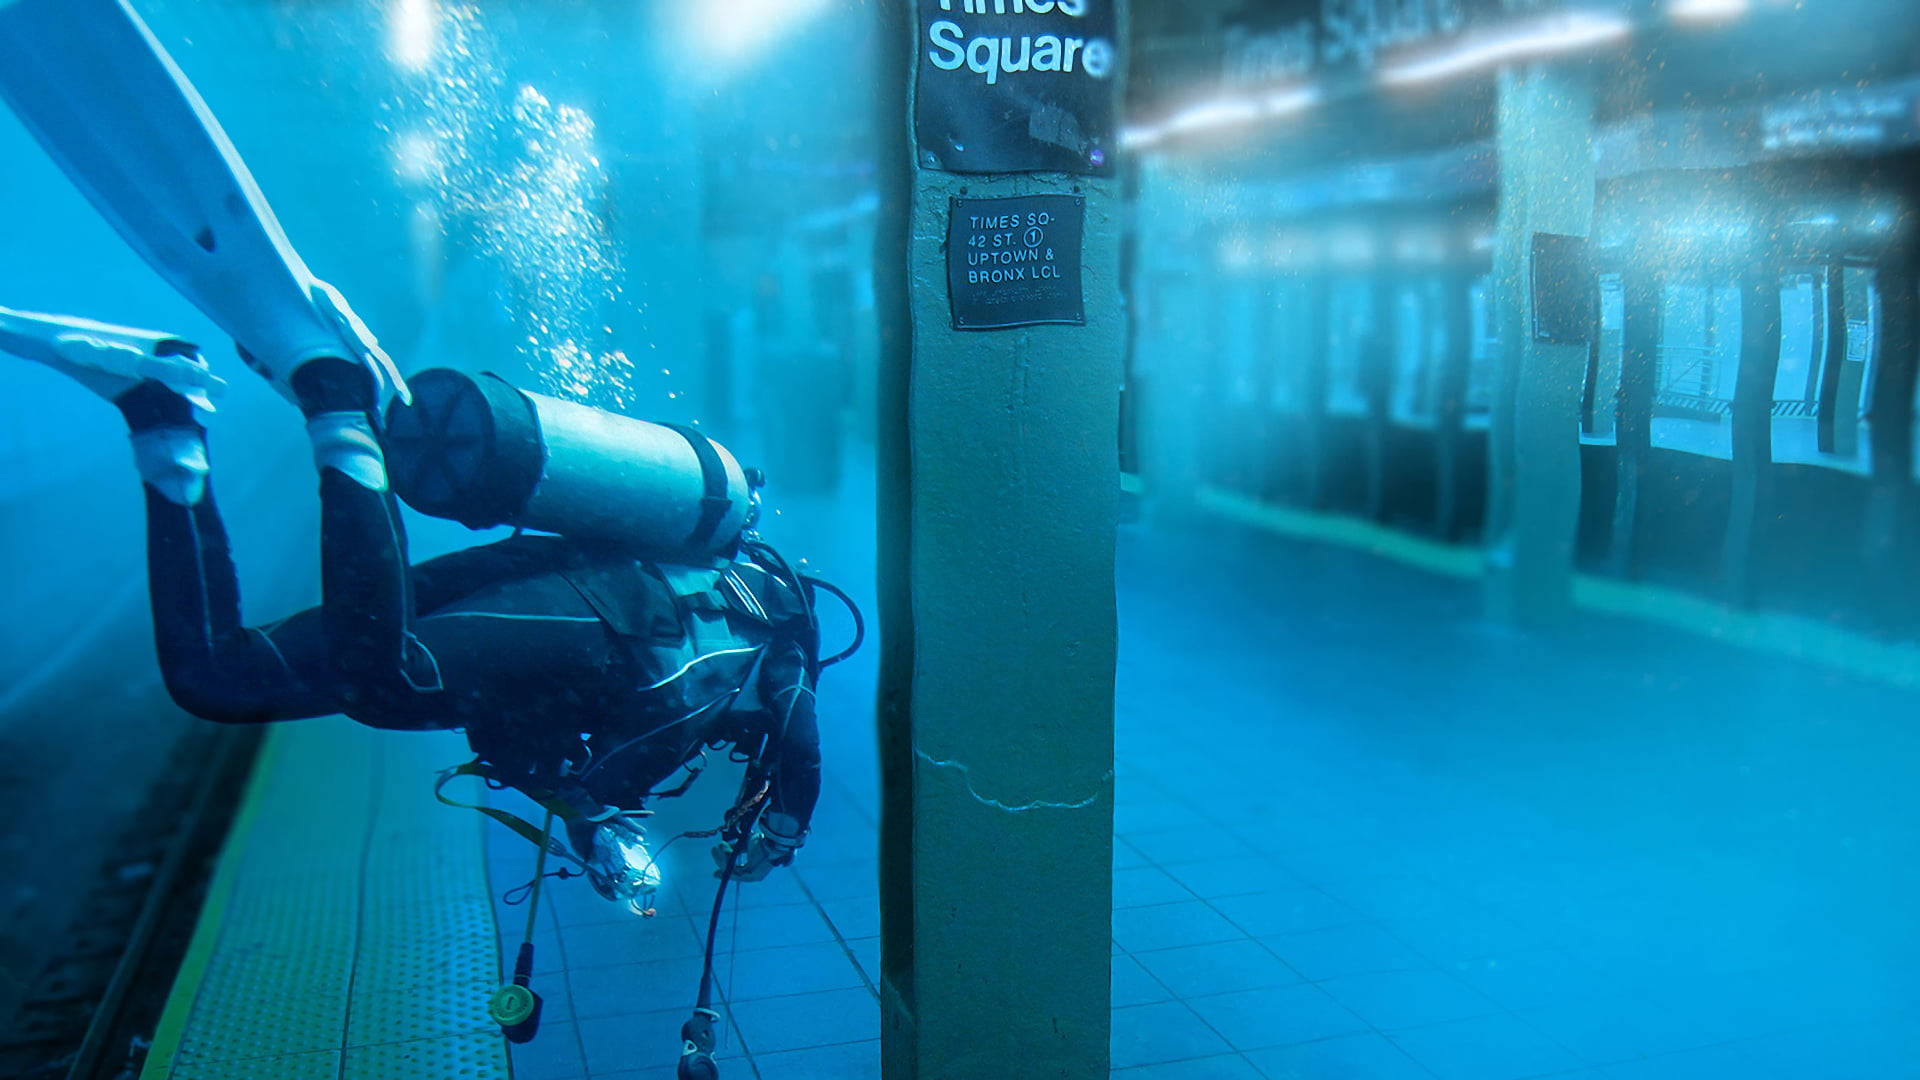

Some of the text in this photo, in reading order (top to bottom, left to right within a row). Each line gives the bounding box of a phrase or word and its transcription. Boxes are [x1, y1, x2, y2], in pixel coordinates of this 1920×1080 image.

[929, 20, 1113, 85] Square
[970, 214, 1020, 229] TIMES
[968, 235, 986, 248] 42
[993, 233, 1017, 247] ST.
[967, 247, 1054, 266] UPTOWN &
[968, 265, 1061, 284] BRONX LCL
